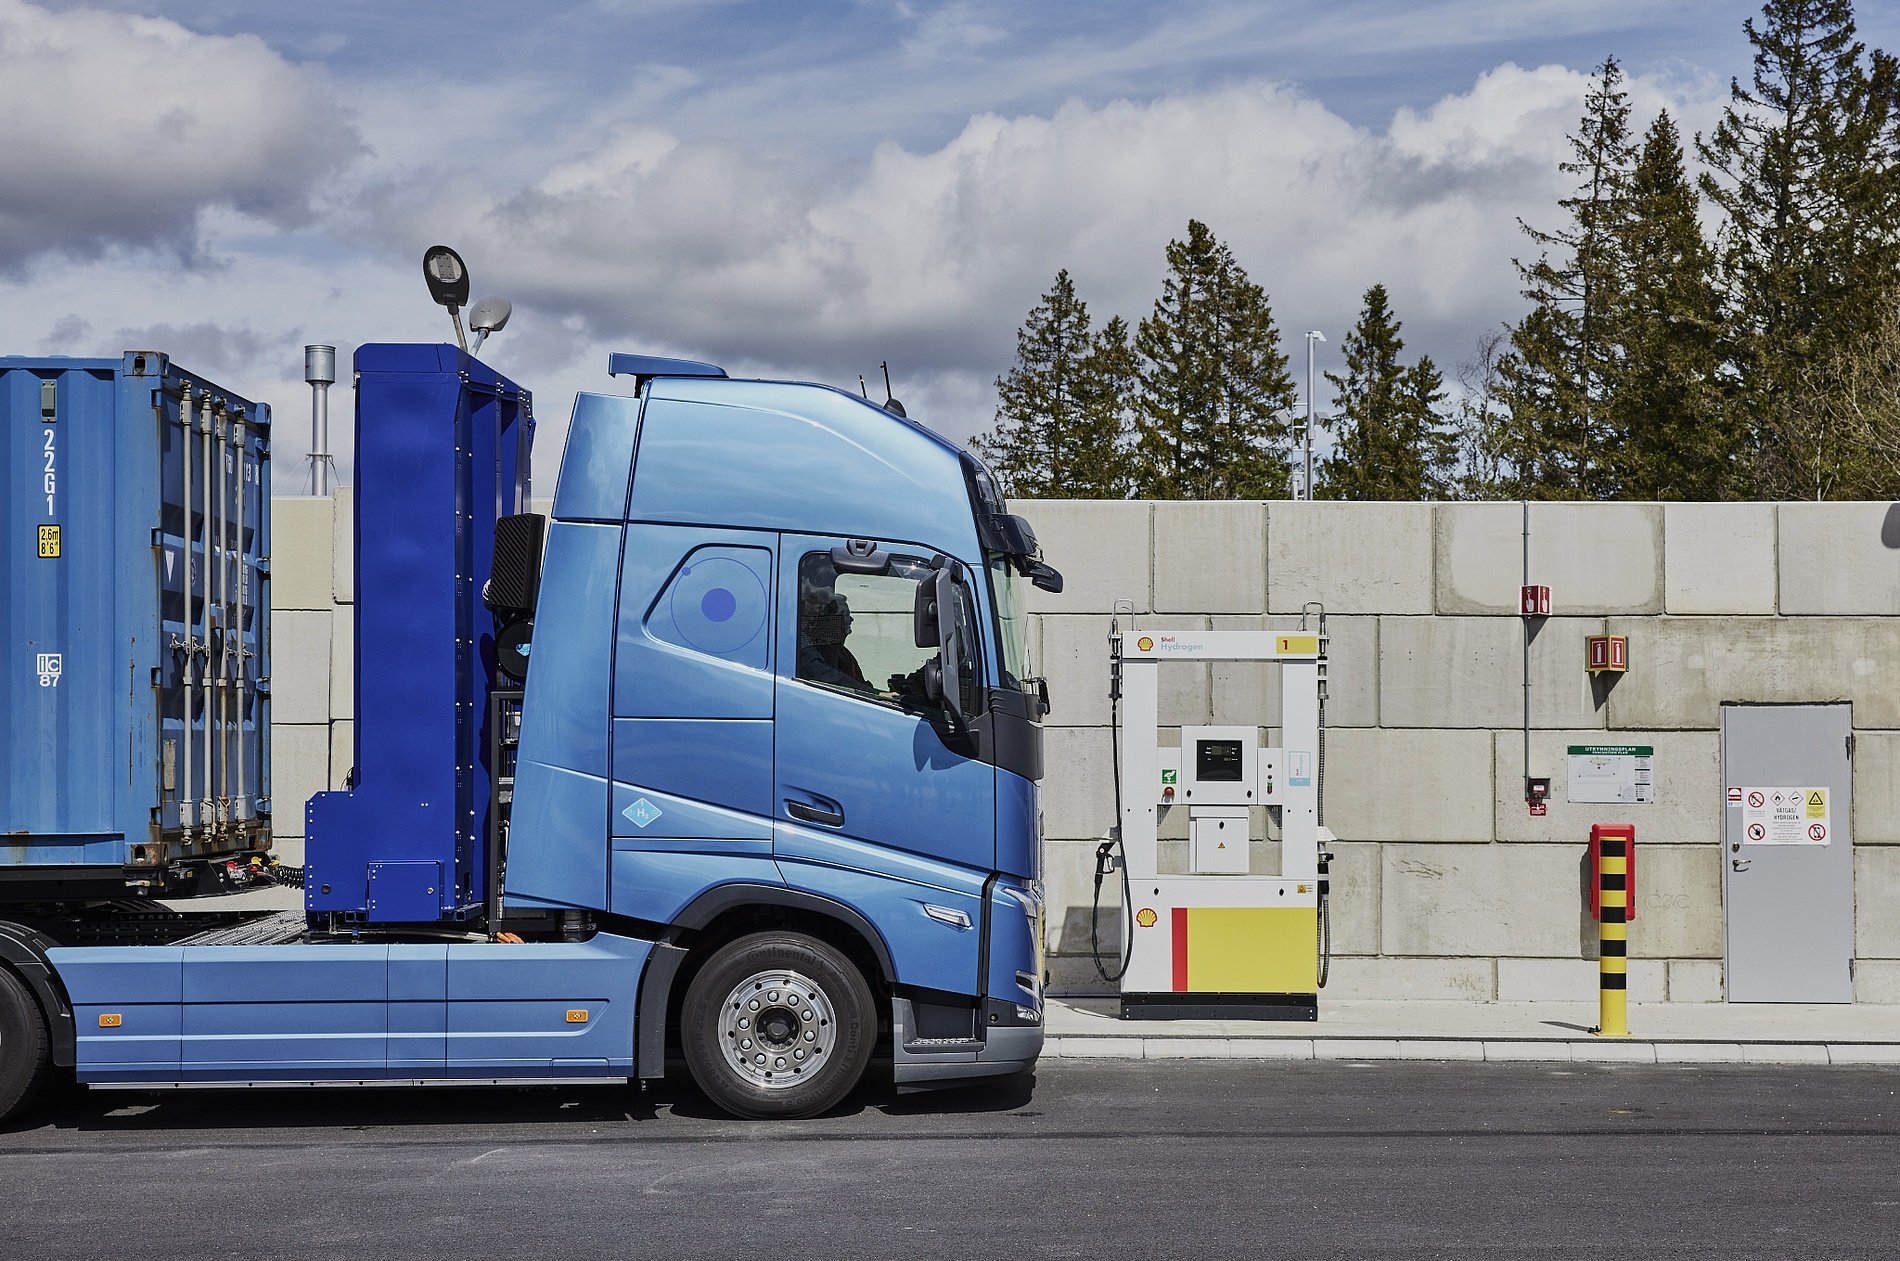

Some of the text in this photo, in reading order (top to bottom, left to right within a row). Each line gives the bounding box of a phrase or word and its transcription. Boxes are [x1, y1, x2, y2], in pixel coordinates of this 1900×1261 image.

[44, 429, 55, 515] 22G1
[41, 528, 58, 540] 2.6m
[1161, 643, 1203, 652] Hydrogen
[1283, 640, 1288, 650] 1
[40, 675, 59, 687] 87
[746, 946, 817, 966] Continental
